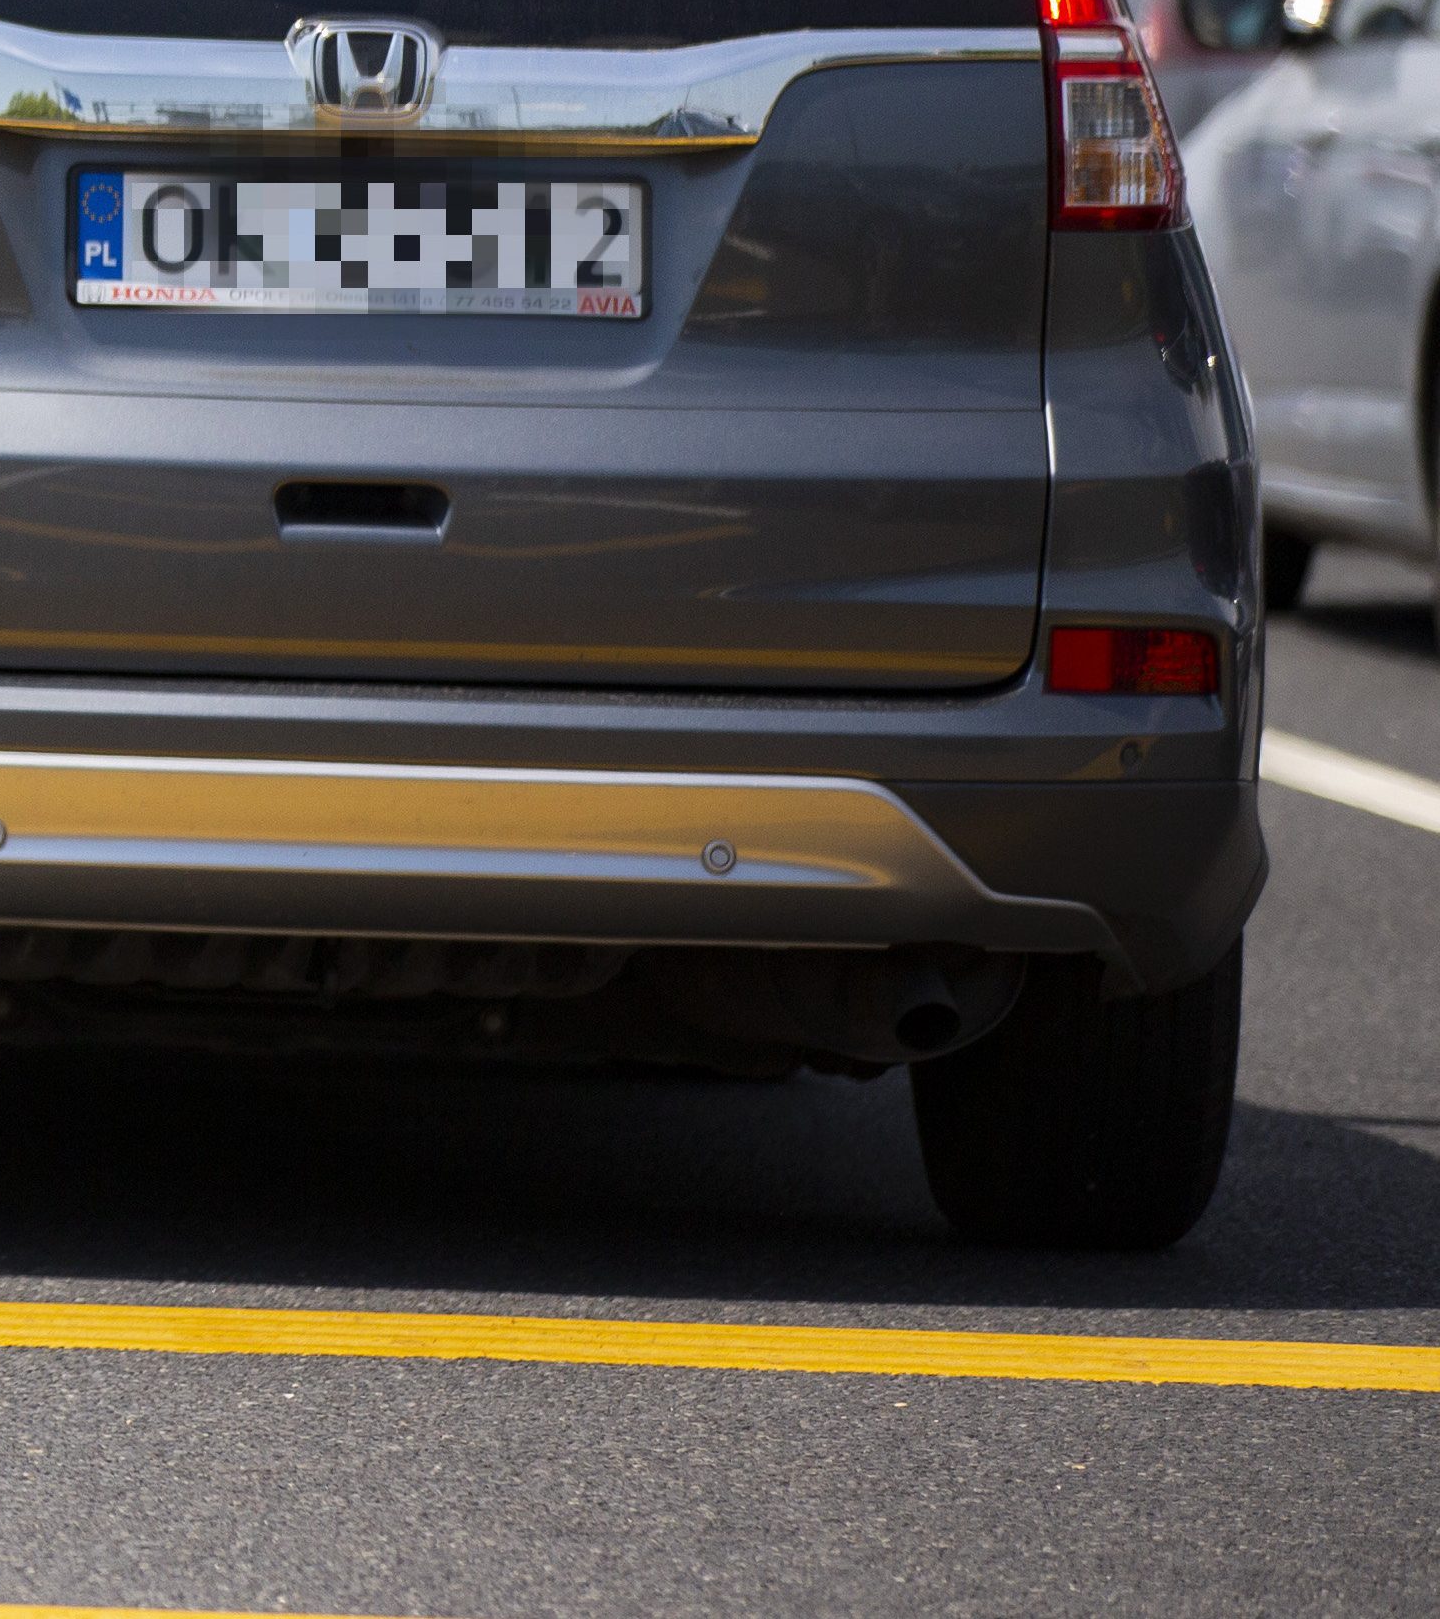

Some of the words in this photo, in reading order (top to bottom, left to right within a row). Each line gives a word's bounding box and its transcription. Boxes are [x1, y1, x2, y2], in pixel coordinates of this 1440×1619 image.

[84, 241, 118, 267] PL
[110, 285, 219, 301] HONDA
[579, 293, 637, 316] AVIA
